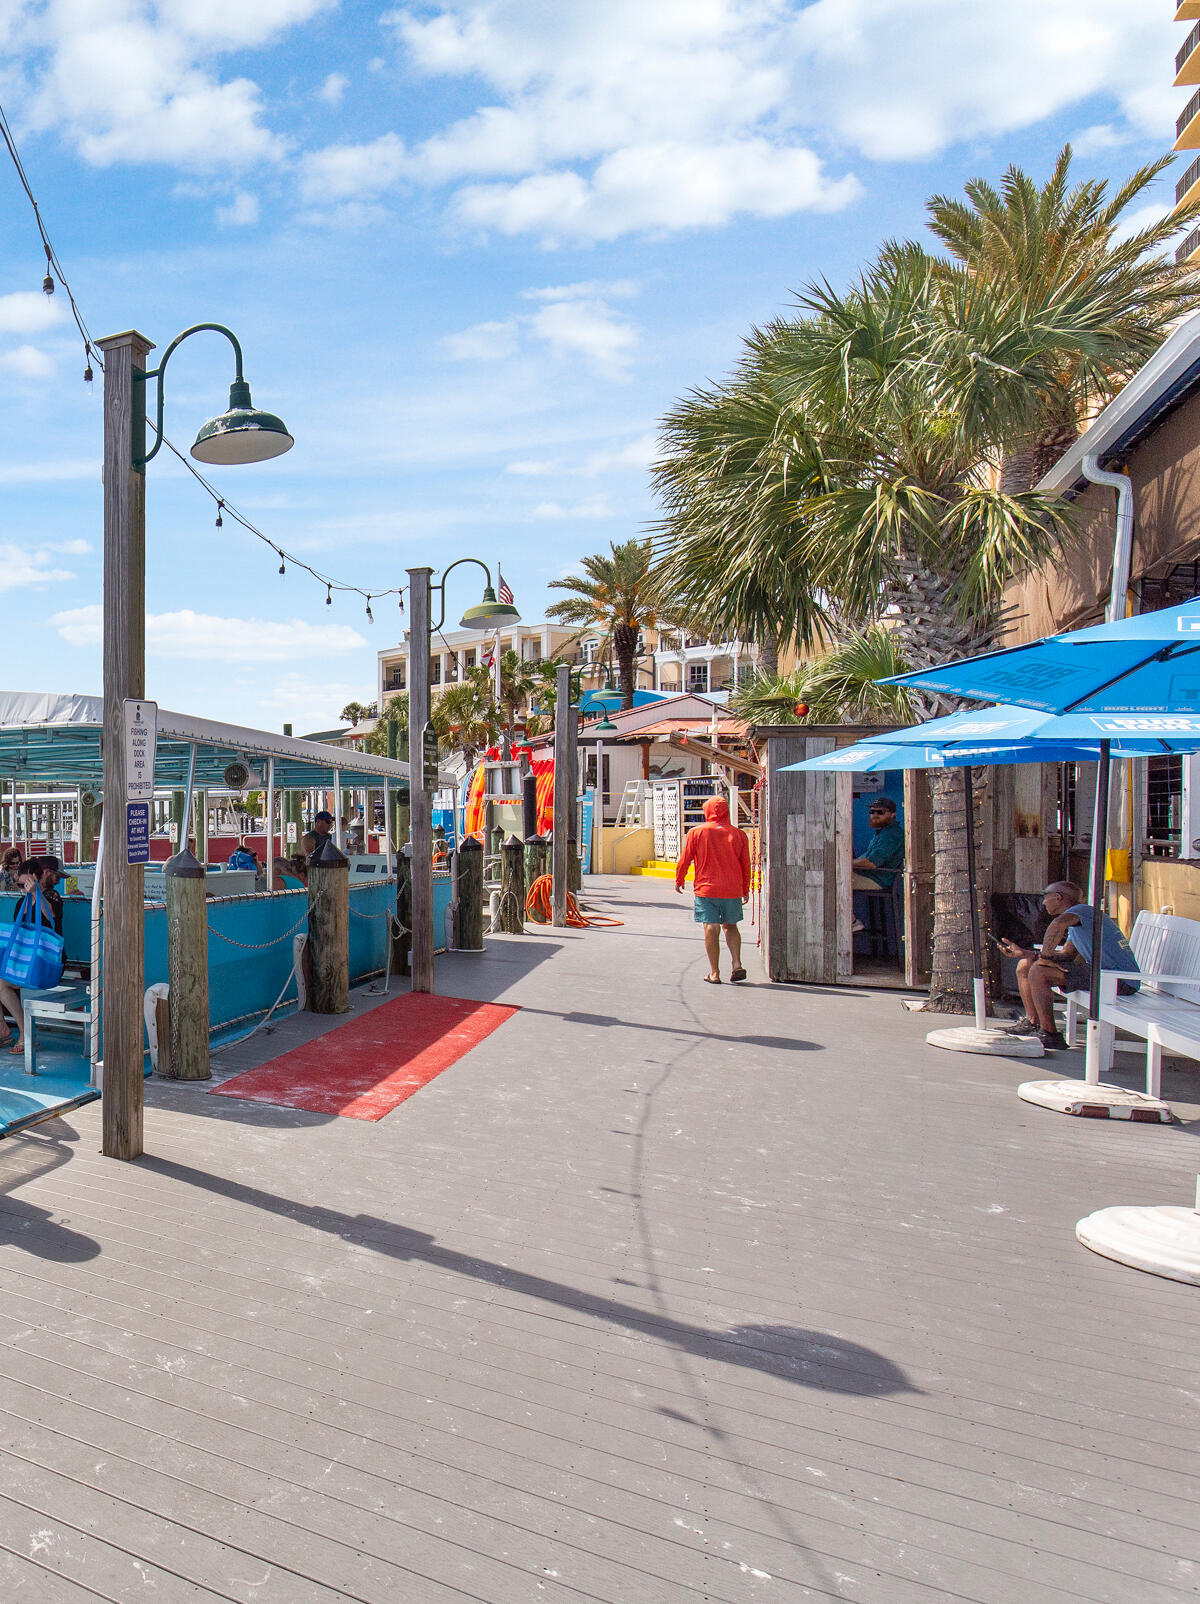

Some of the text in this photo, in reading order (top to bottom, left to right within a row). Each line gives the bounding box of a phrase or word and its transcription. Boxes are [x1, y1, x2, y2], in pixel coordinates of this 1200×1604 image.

[131, 728, 148, 736] FISHING
[132, 739, 146, 747] ALONG
[134, 760, 145, 768] AREA
[128, 782, 151, 790] PROHIBITED
